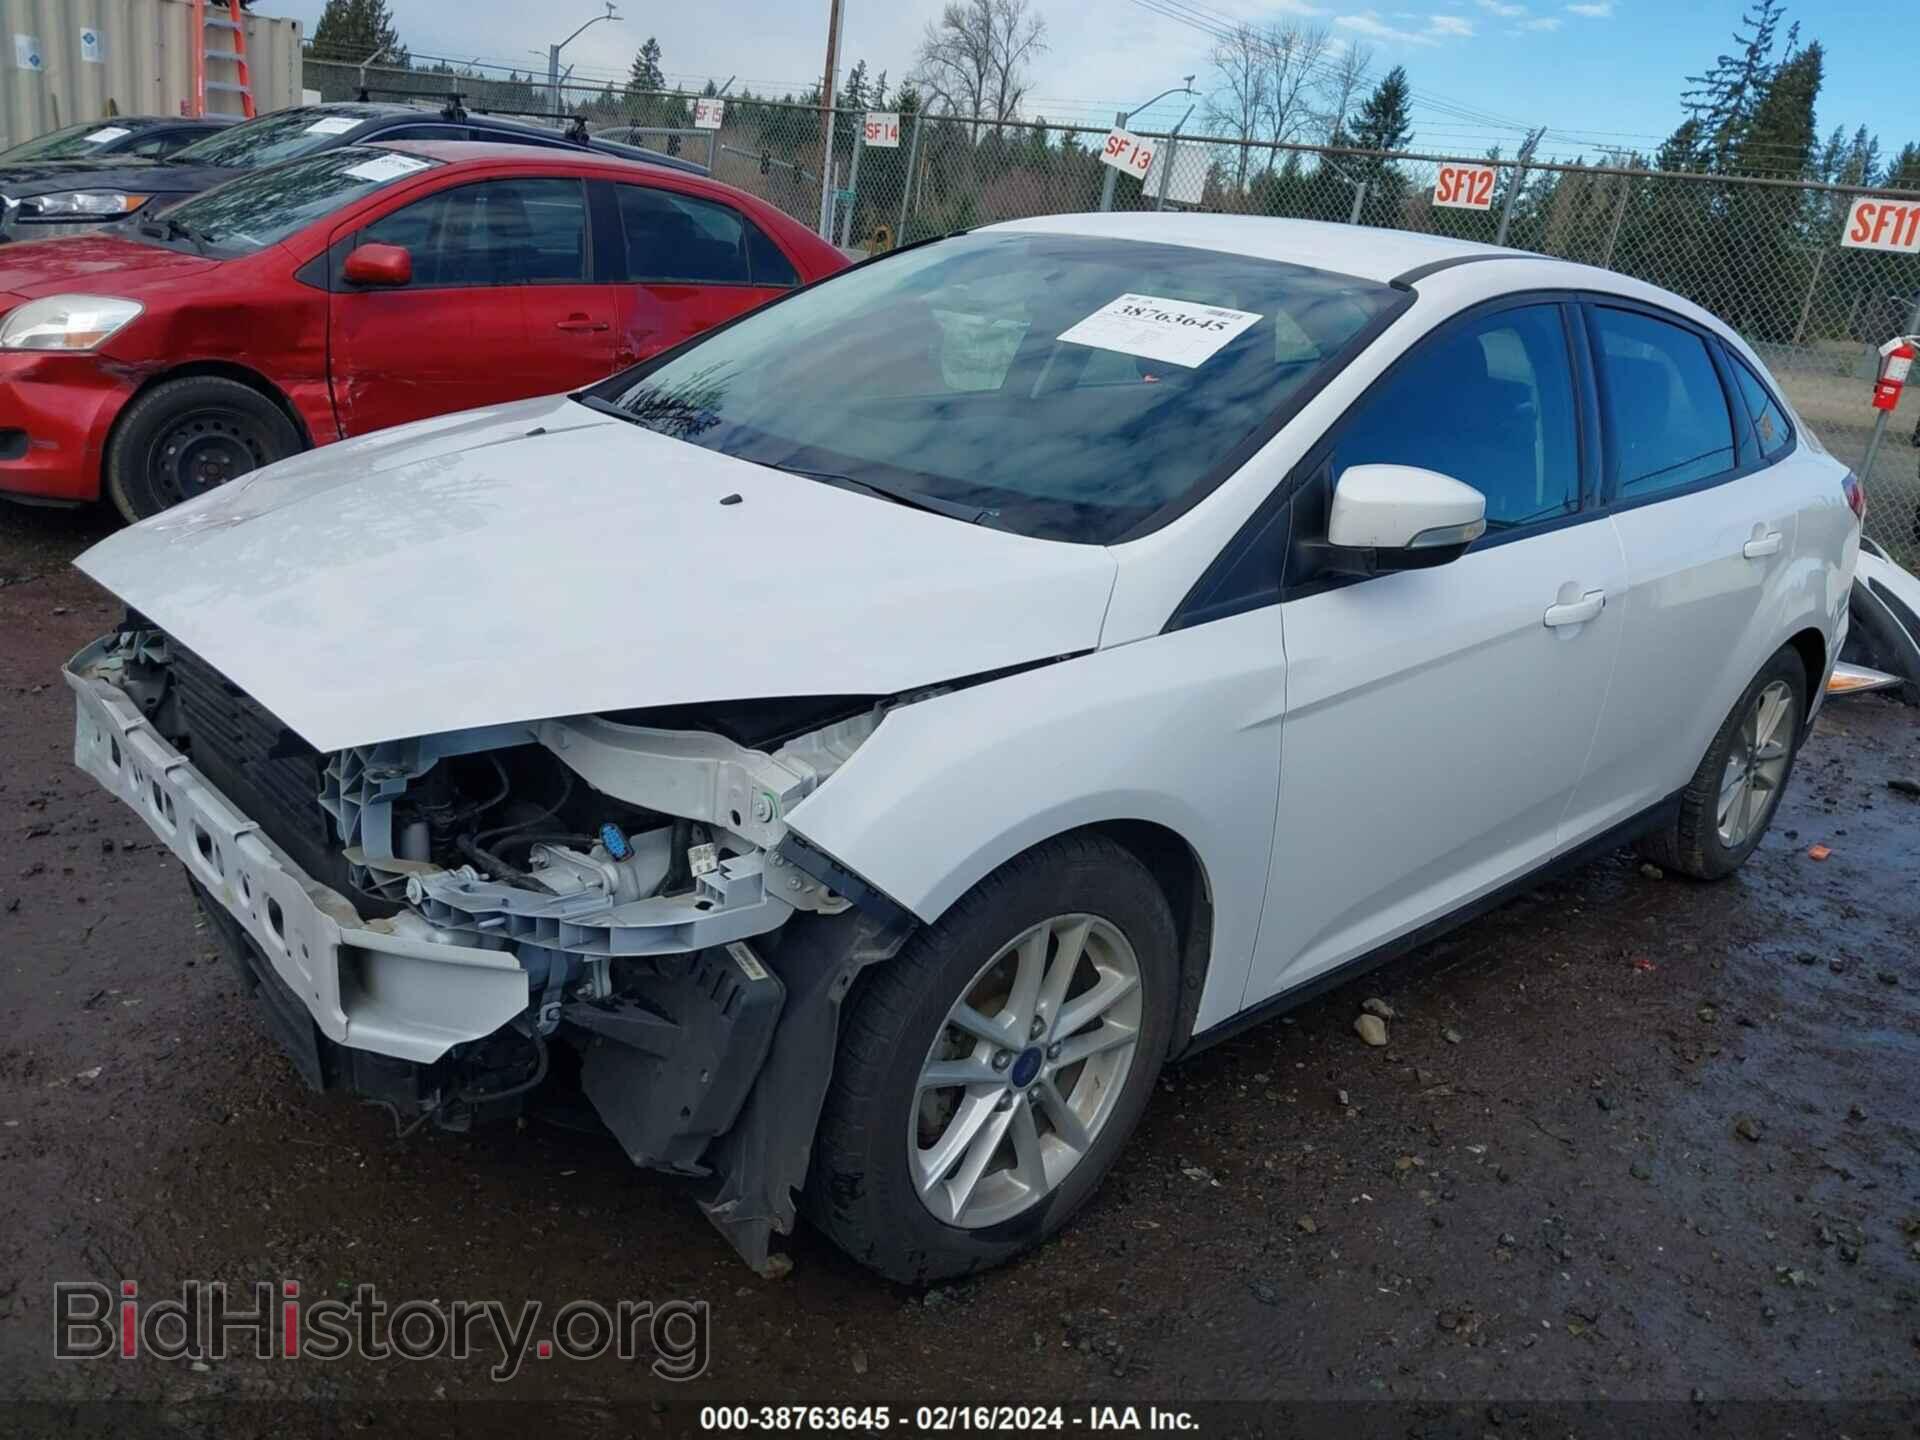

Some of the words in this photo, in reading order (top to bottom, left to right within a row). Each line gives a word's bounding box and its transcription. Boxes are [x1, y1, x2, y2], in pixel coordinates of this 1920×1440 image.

[697, 104, 709, 120] SF
[867, 122, 881, 139] SF
[885, 123, 897, 141] 14
[1105, 136, 1130, 157] SF
[1130, 144, 1151, 169] 13
[1437, 168, 1493, 204] SF12
[1851, 203, 1920, 246] SF11
[1114, 305, 1229, 331] 38763645
